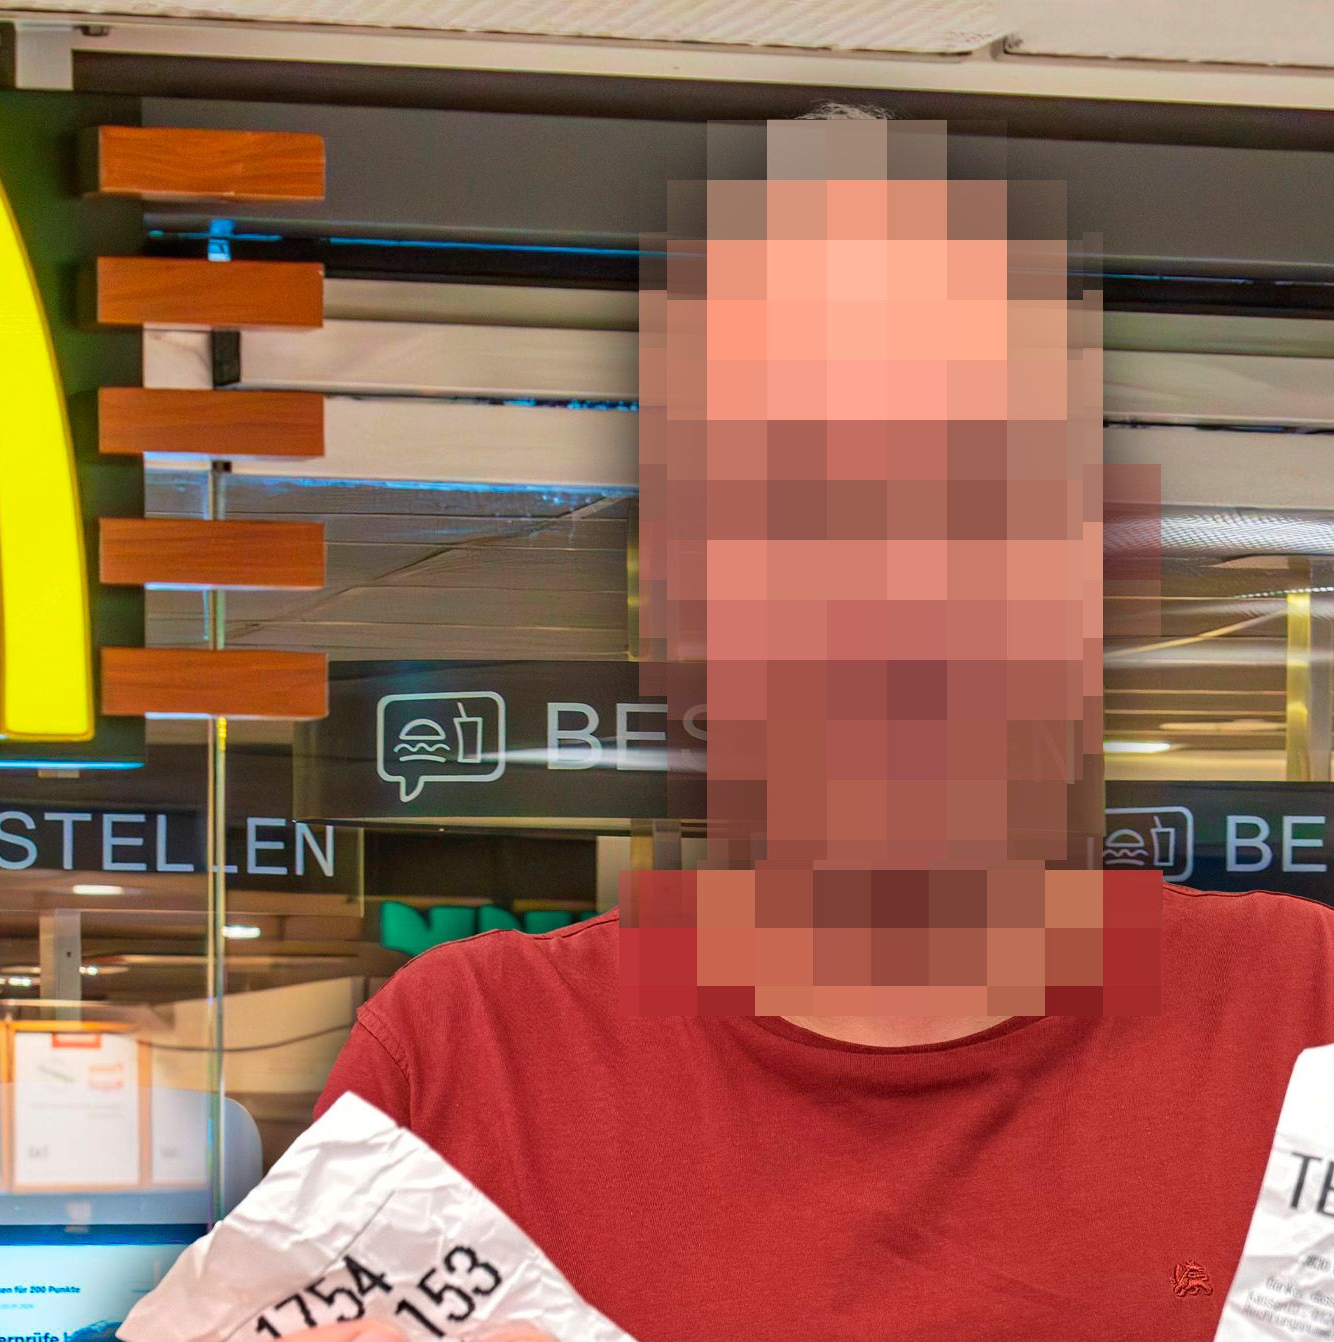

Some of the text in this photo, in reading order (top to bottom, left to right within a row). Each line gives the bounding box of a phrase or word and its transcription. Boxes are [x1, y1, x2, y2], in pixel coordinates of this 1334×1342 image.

[14, 1286, 27, 1294] für
[30, 1286, 46, 1294] 200
[48, 1286, 80, 1294] Punkte
[395, 1246, 503, 1338] 153
